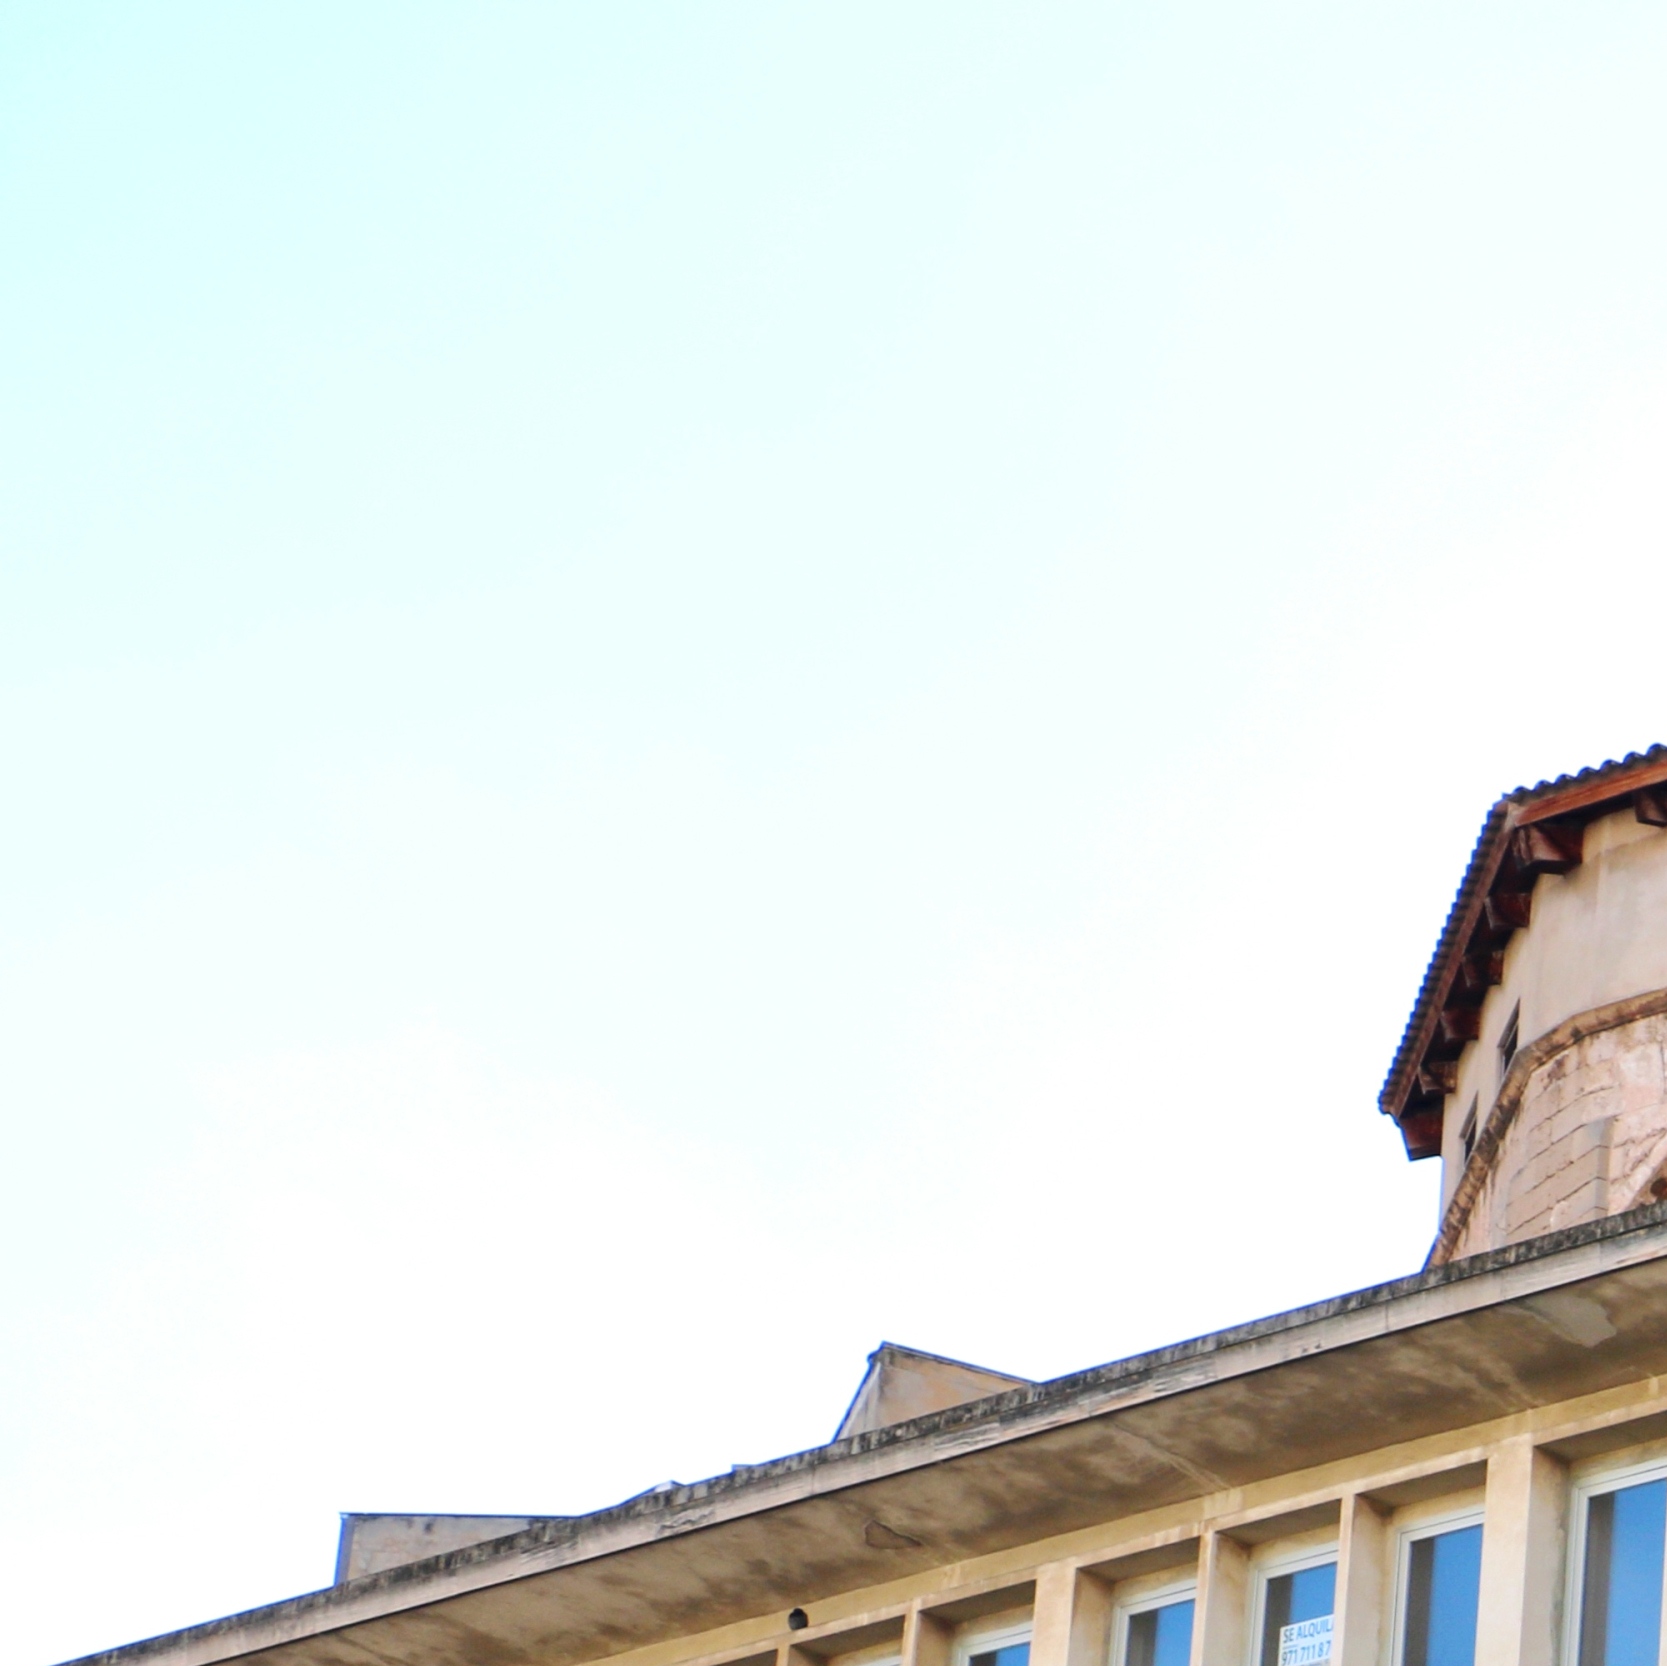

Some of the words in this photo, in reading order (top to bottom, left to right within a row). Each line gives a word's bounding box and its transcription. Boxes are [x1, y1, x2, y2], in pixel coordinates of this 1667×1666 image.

[1283, 1627, 1295, 1643] SE
[1296, 1622, 1333, 1640] ALQUIL
[1281, 1648, 1298, 1666] 971
[1300, 1645, 1316, 1662] 711
[1317, 1640, 1332, 1657] 87
